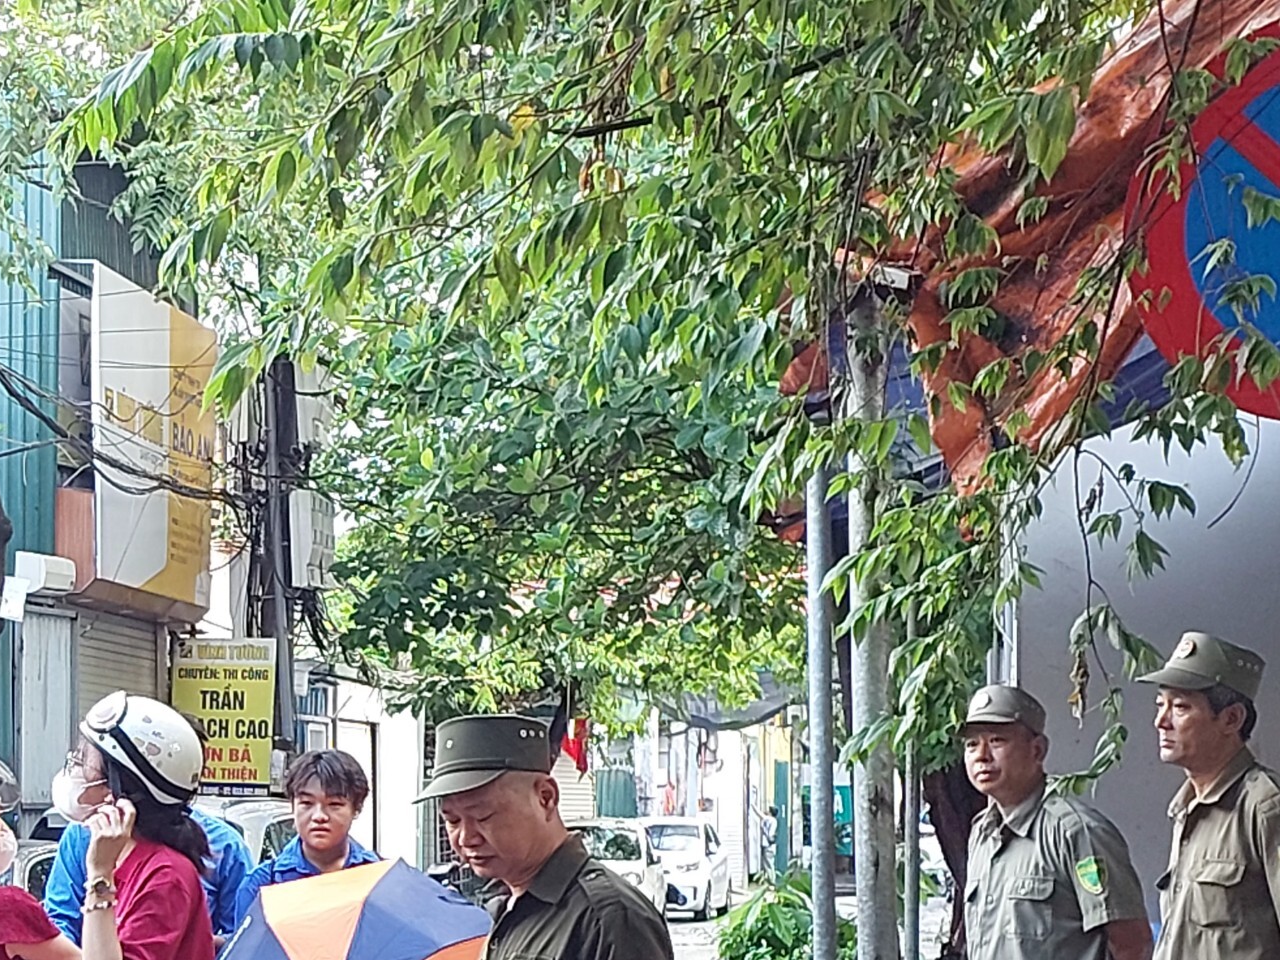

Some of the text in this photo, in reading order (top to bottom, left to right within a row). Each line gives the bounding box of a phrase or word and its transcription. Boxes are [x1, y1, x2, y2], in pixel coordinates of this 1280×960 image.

[223, 668, 238, 680] THI
[241, 666, 269, 681] CÔNG
[200, 683, 245, 711] TRẦN
[235, 718, 269, 740] CAO
